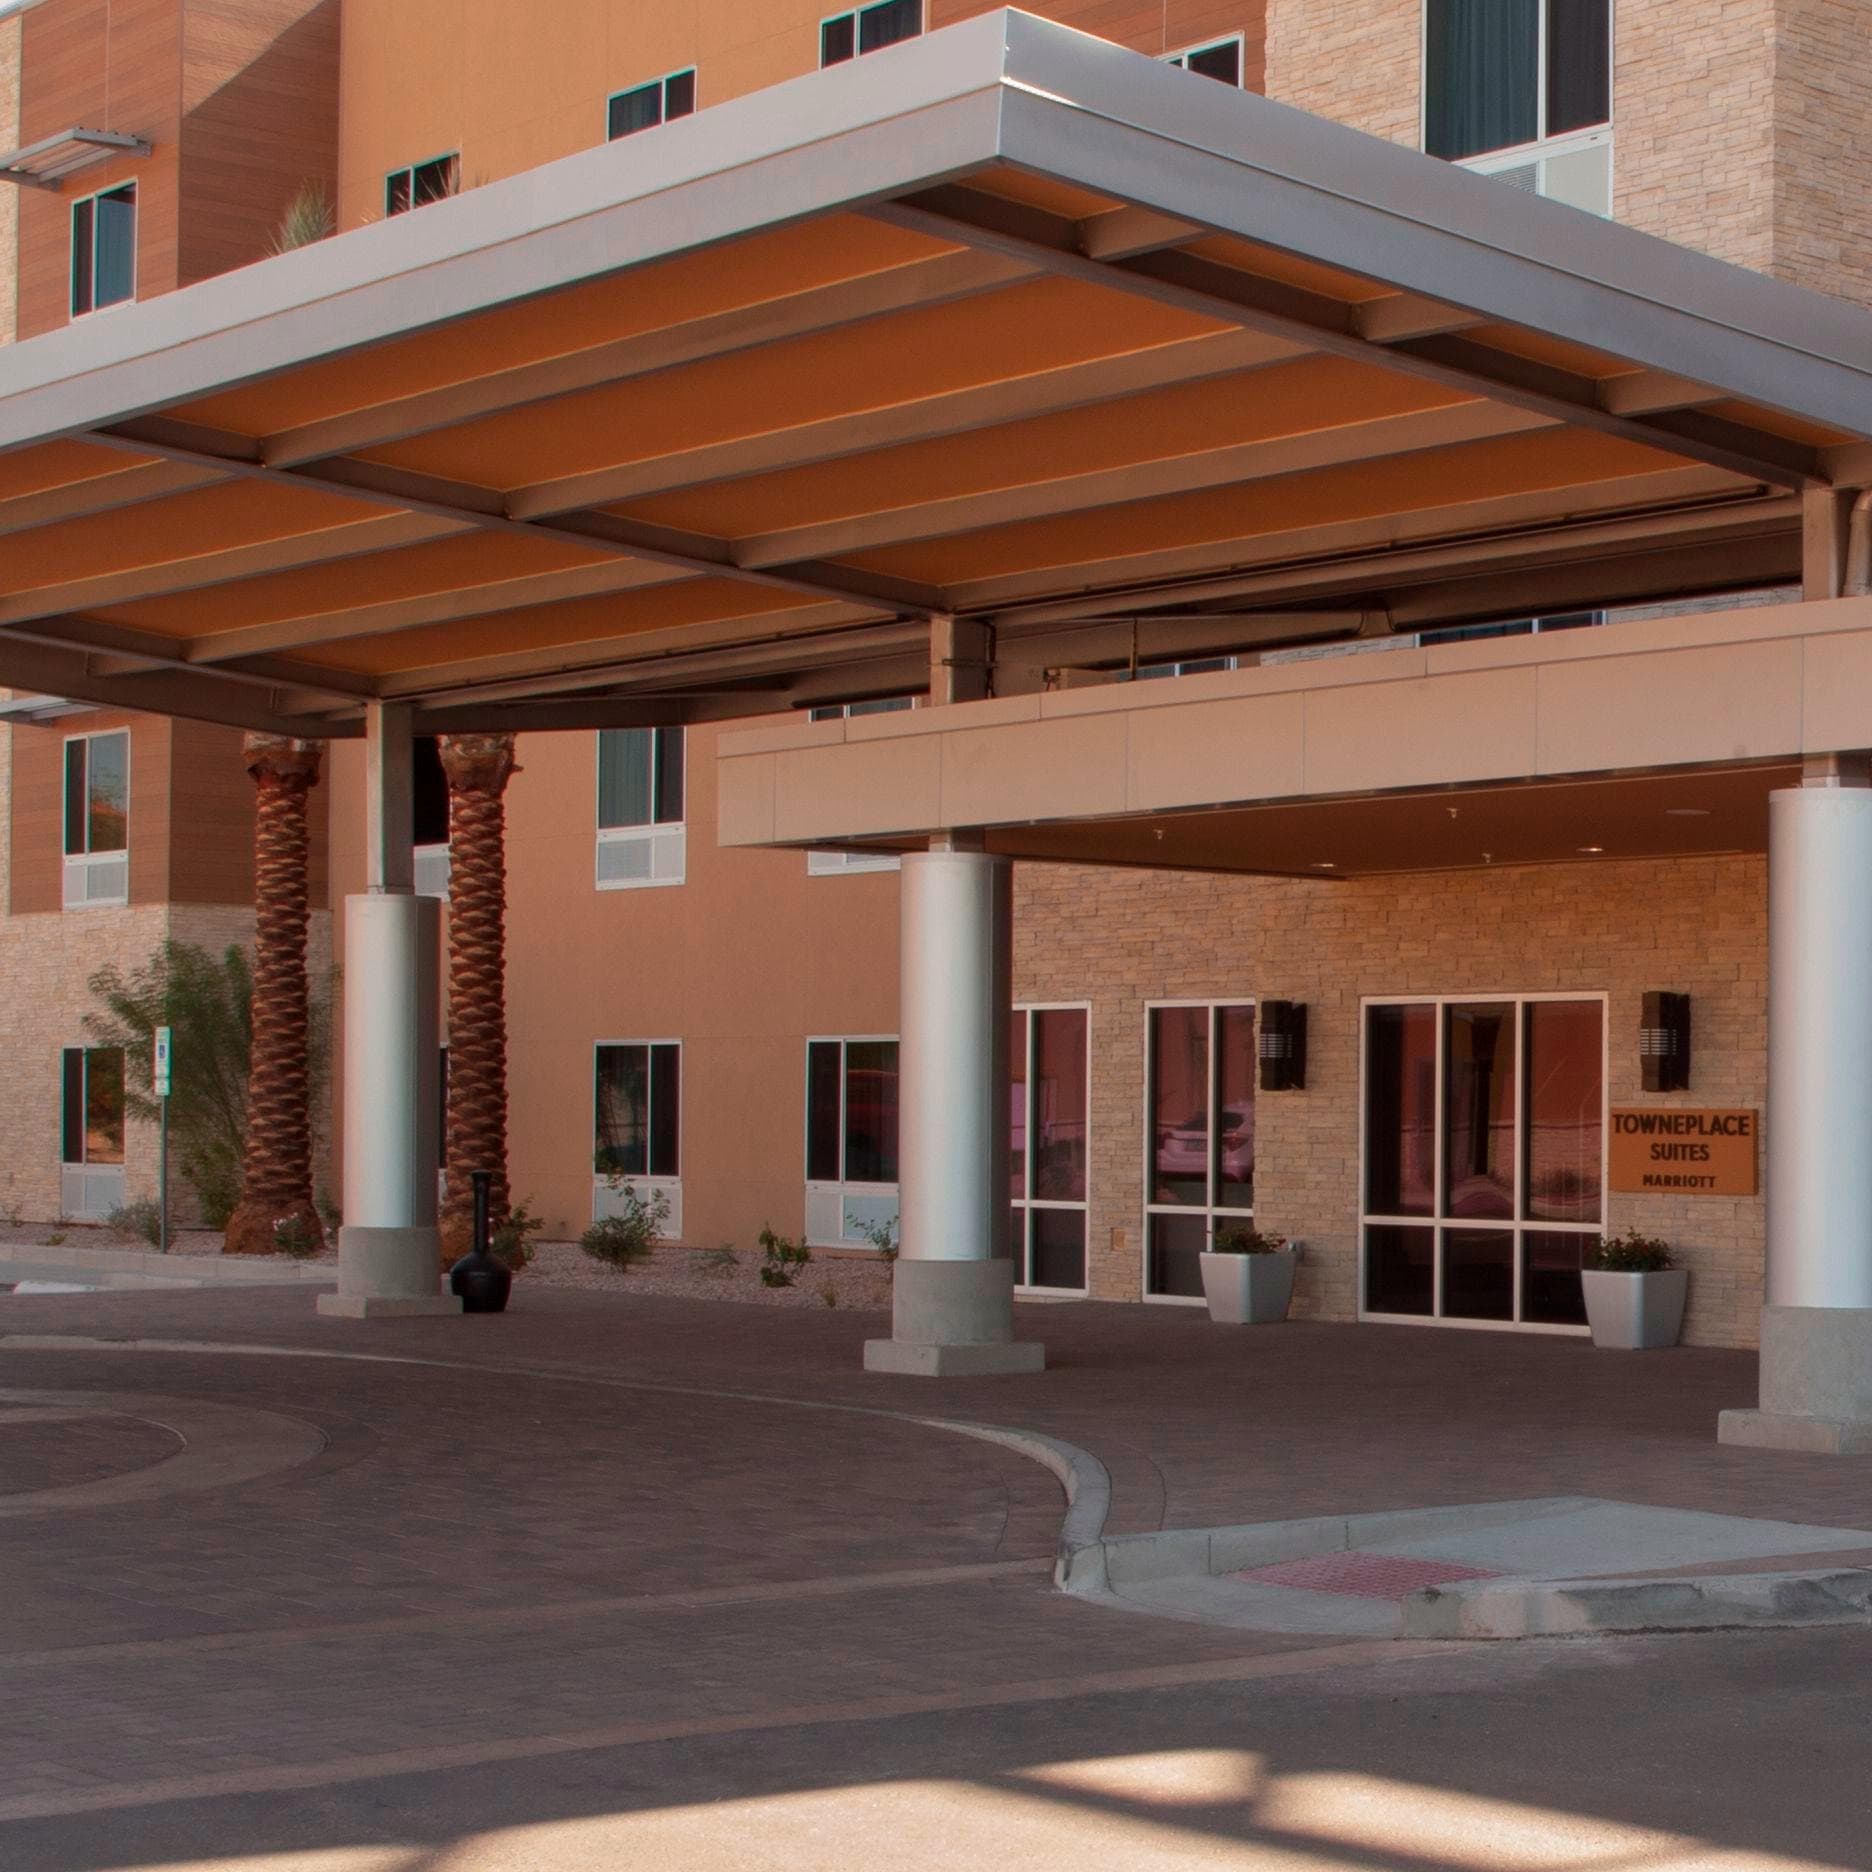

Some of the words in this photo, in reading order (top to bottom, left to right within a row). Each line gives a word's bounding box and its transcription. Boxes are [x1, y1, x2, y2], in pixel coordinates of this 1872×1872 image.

[1613, 1114, 1750, 1136] TOWNEPLACE
[1650, 1143, 1710, 1162] SUITES
[1642, 1174, 1716, 1188] MARRIOTT
